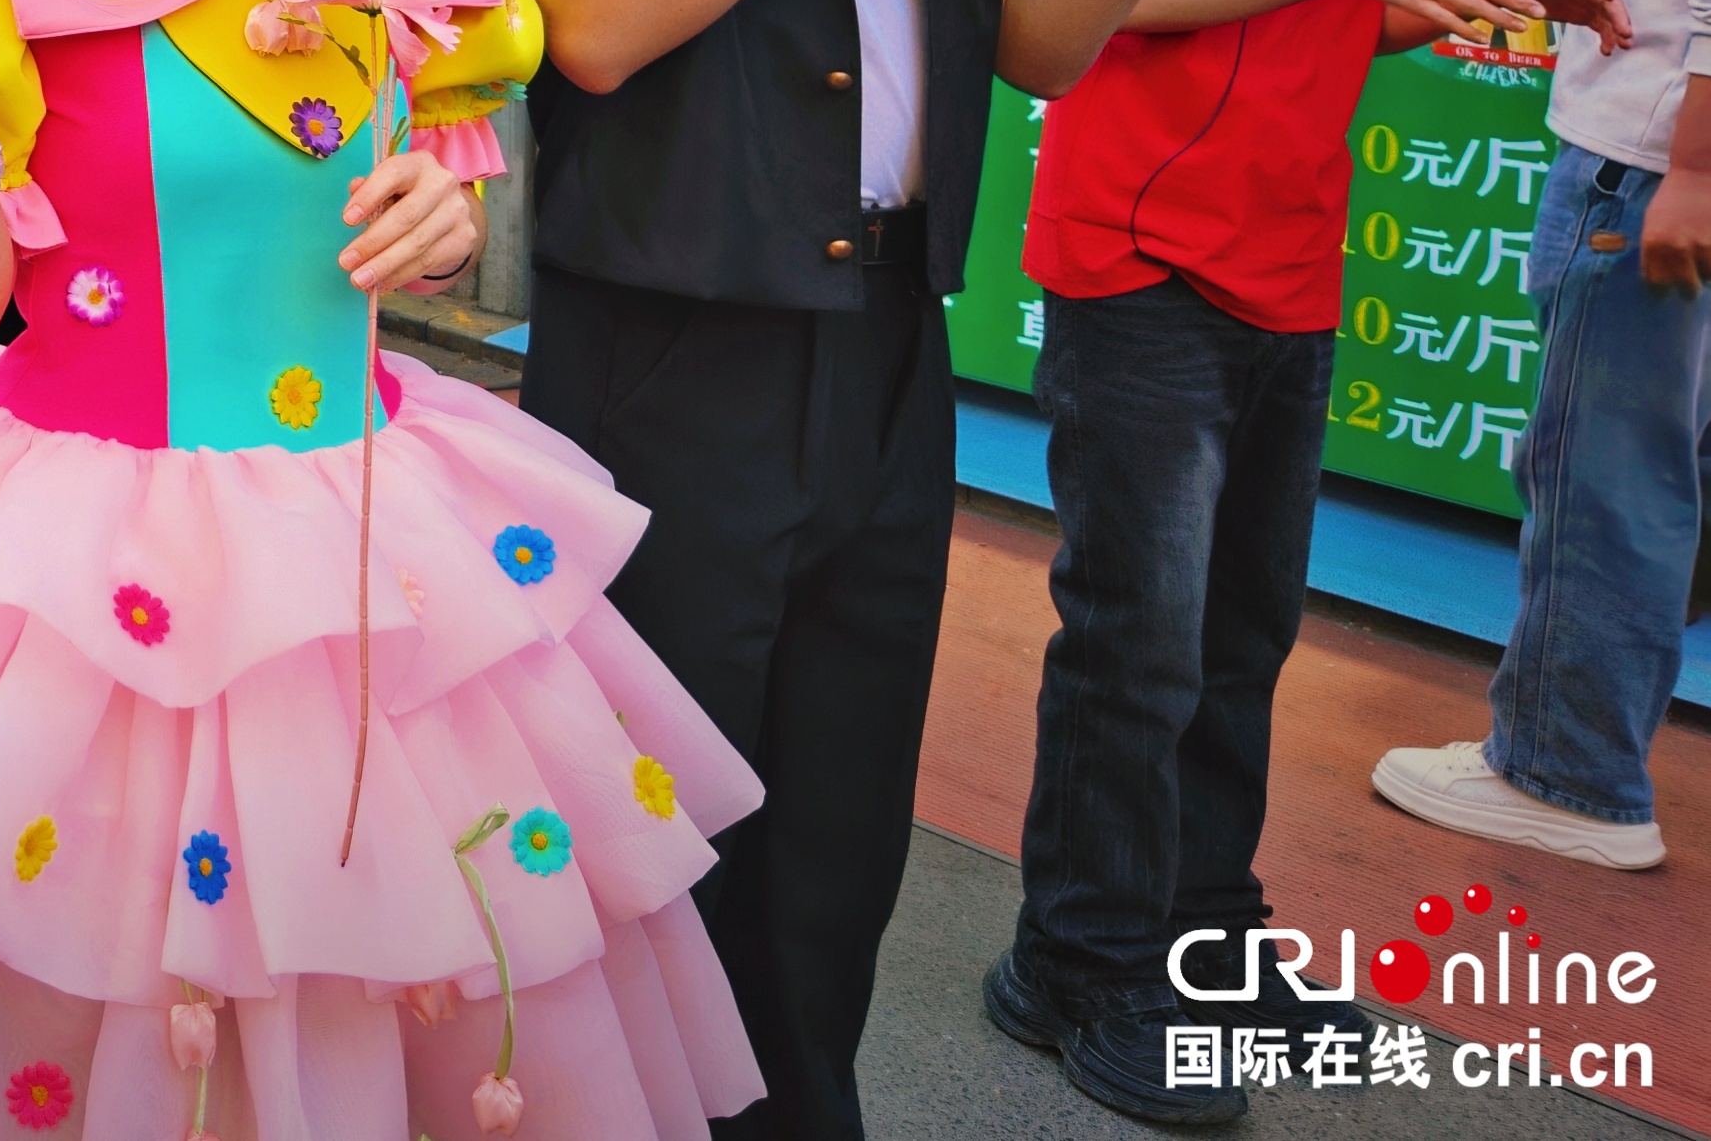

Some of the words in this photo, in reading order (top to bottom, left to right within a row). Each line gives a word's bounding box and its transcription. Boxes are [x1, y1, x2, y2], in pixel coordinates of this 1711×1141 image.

[1341, 211, 1534, 295] 0元/斤
[1336, 296, 1540, 383] 0元/斤
[1327, 380, 1529, 472] 2元/斤
